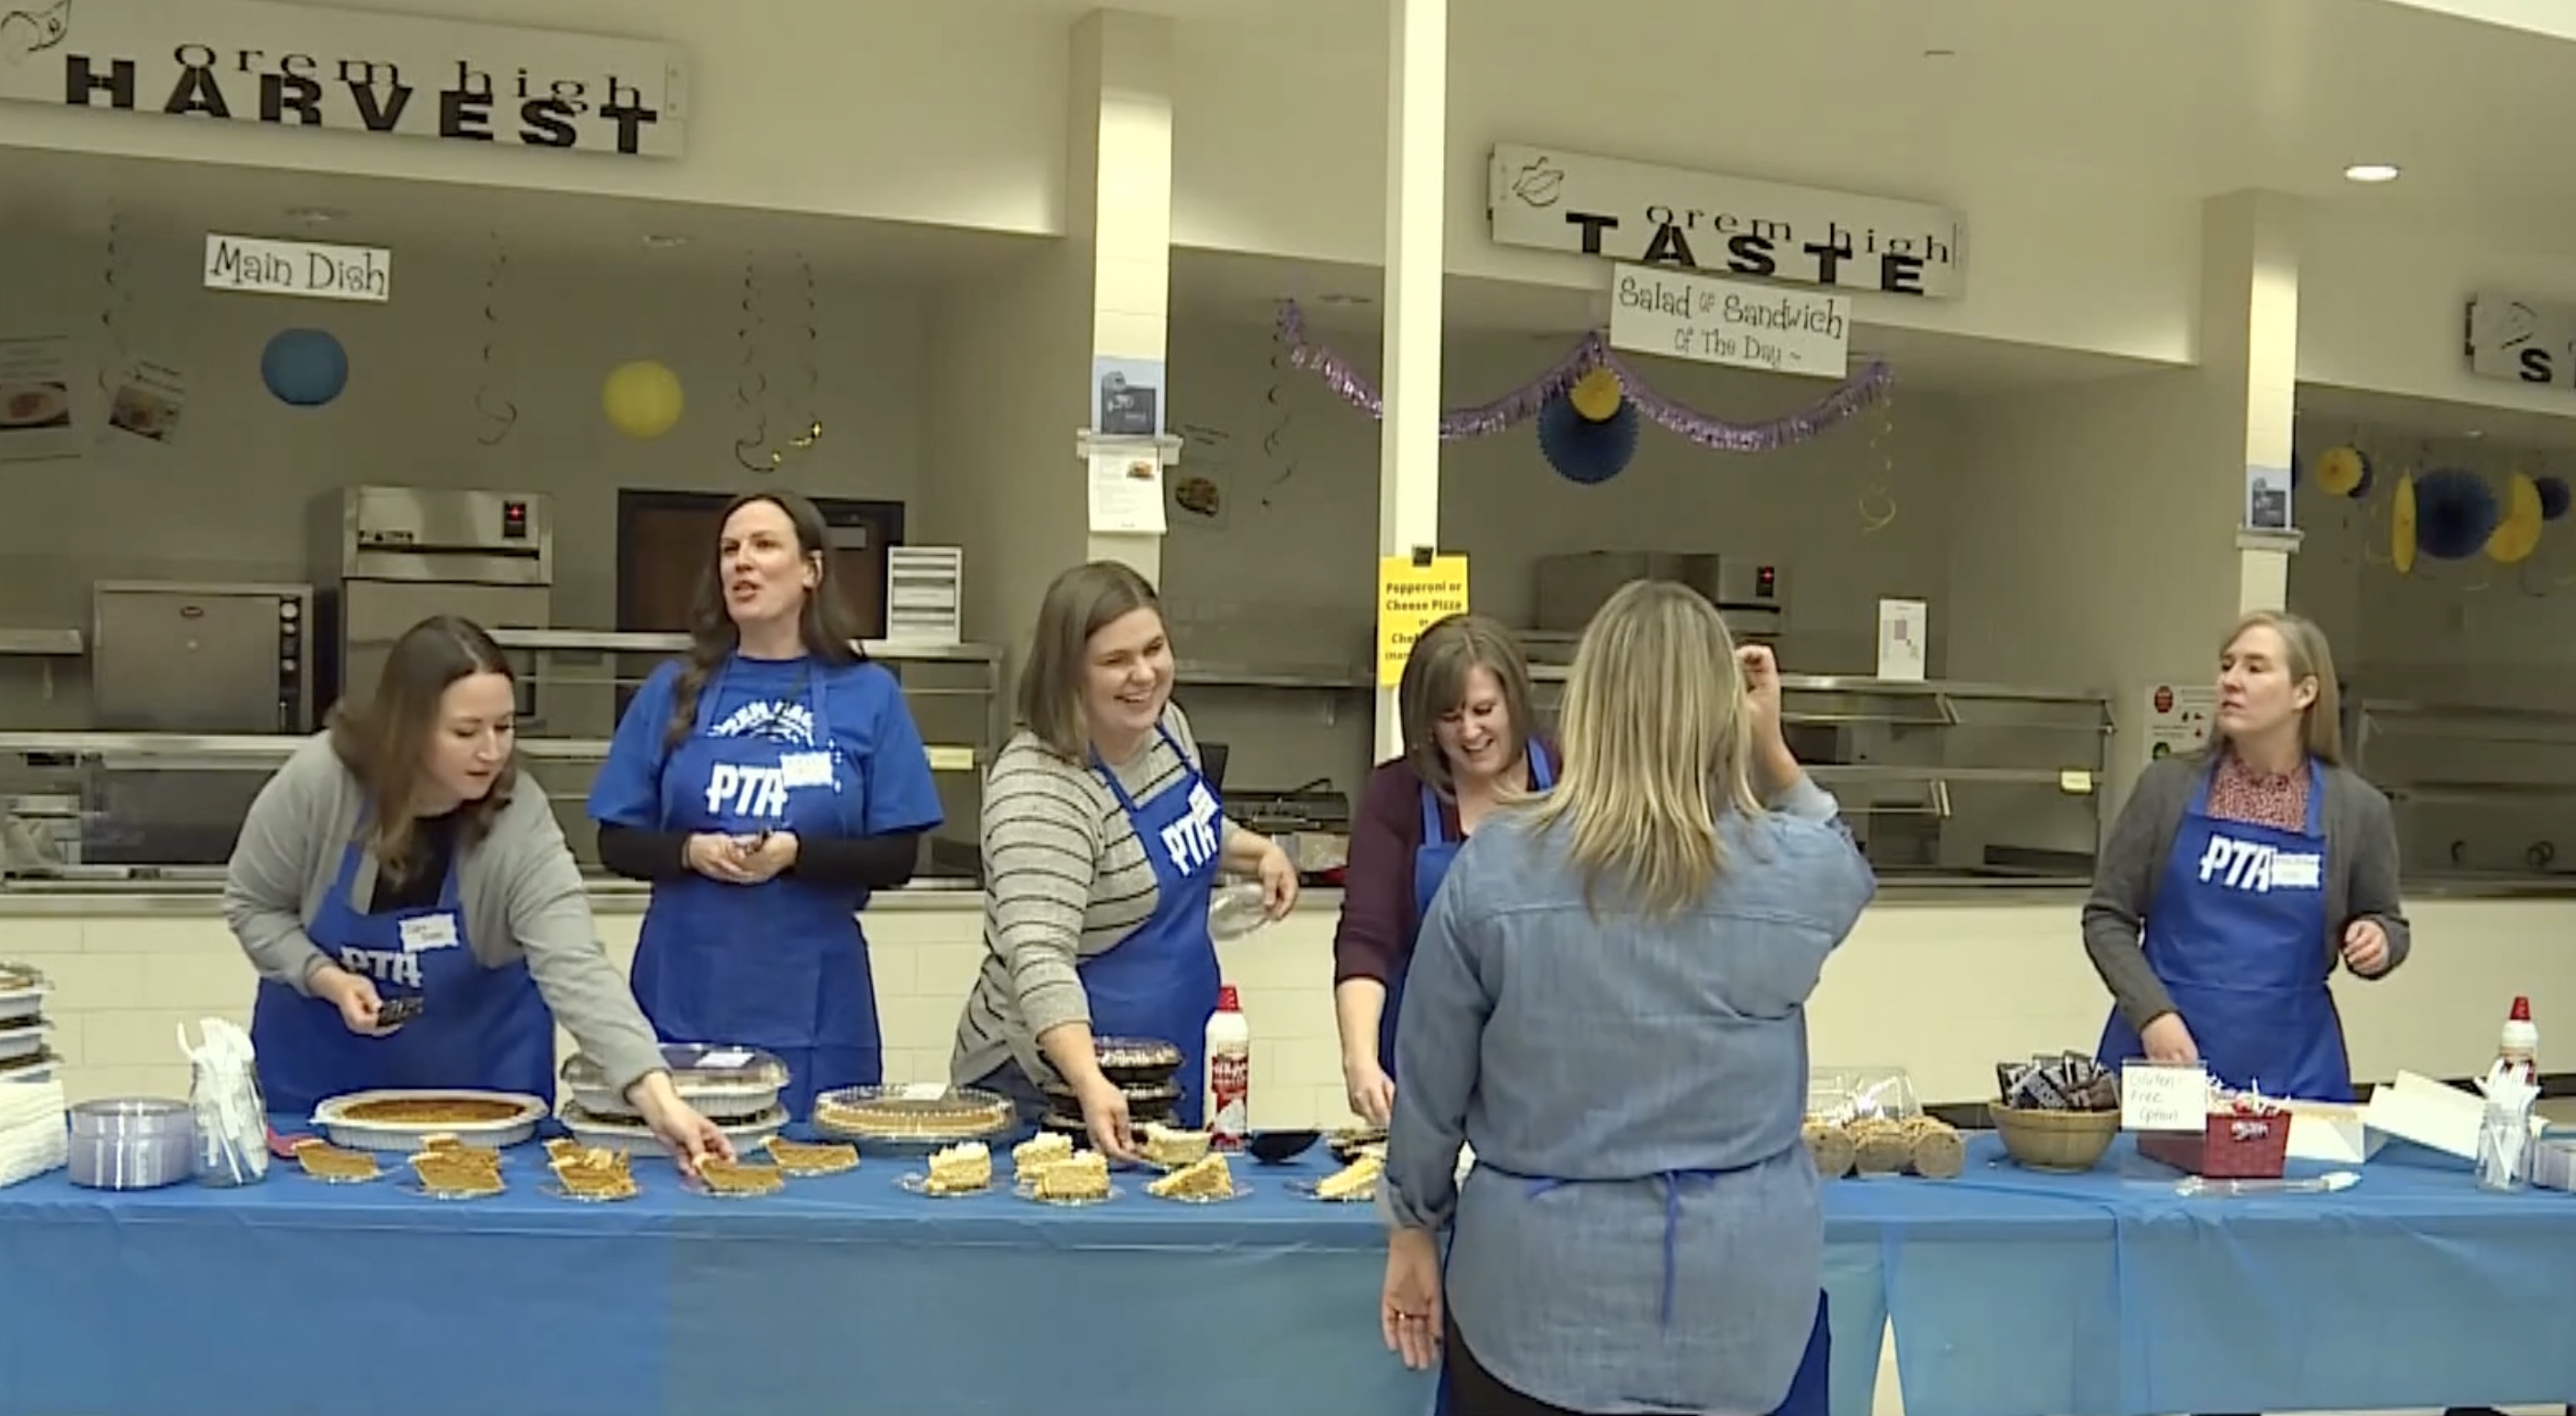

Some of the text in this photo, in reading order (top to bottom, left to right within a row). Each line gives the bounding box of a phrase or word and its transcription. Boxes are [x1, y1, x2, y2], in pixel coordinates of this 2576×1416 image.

[174, 43, 400, 85] orem
[65, 53, 658, 154] HARVEST
[1645, 205, 1792, 241] orem
[209, 239, 386, 296] Main Dish
[1565, 211, 1925, 294] TASTE
[1620, 276, 1692, 319] Salad
[1723, 294, 1844, 341] Sandwich
[1702, 328, 1736, 357] The
[1745, 334, 1781, 366] Day
[1385, 581, 1446, 595] Pepperoni
[1385, 599, 1463, 611] Cheese Pizza
[706, 763, 788, 817] PTA
[1160, 811, 1218, 877] PTA
[2198, 834, 2278, 893] PTA
[339, 946, 424, 989] PTA
